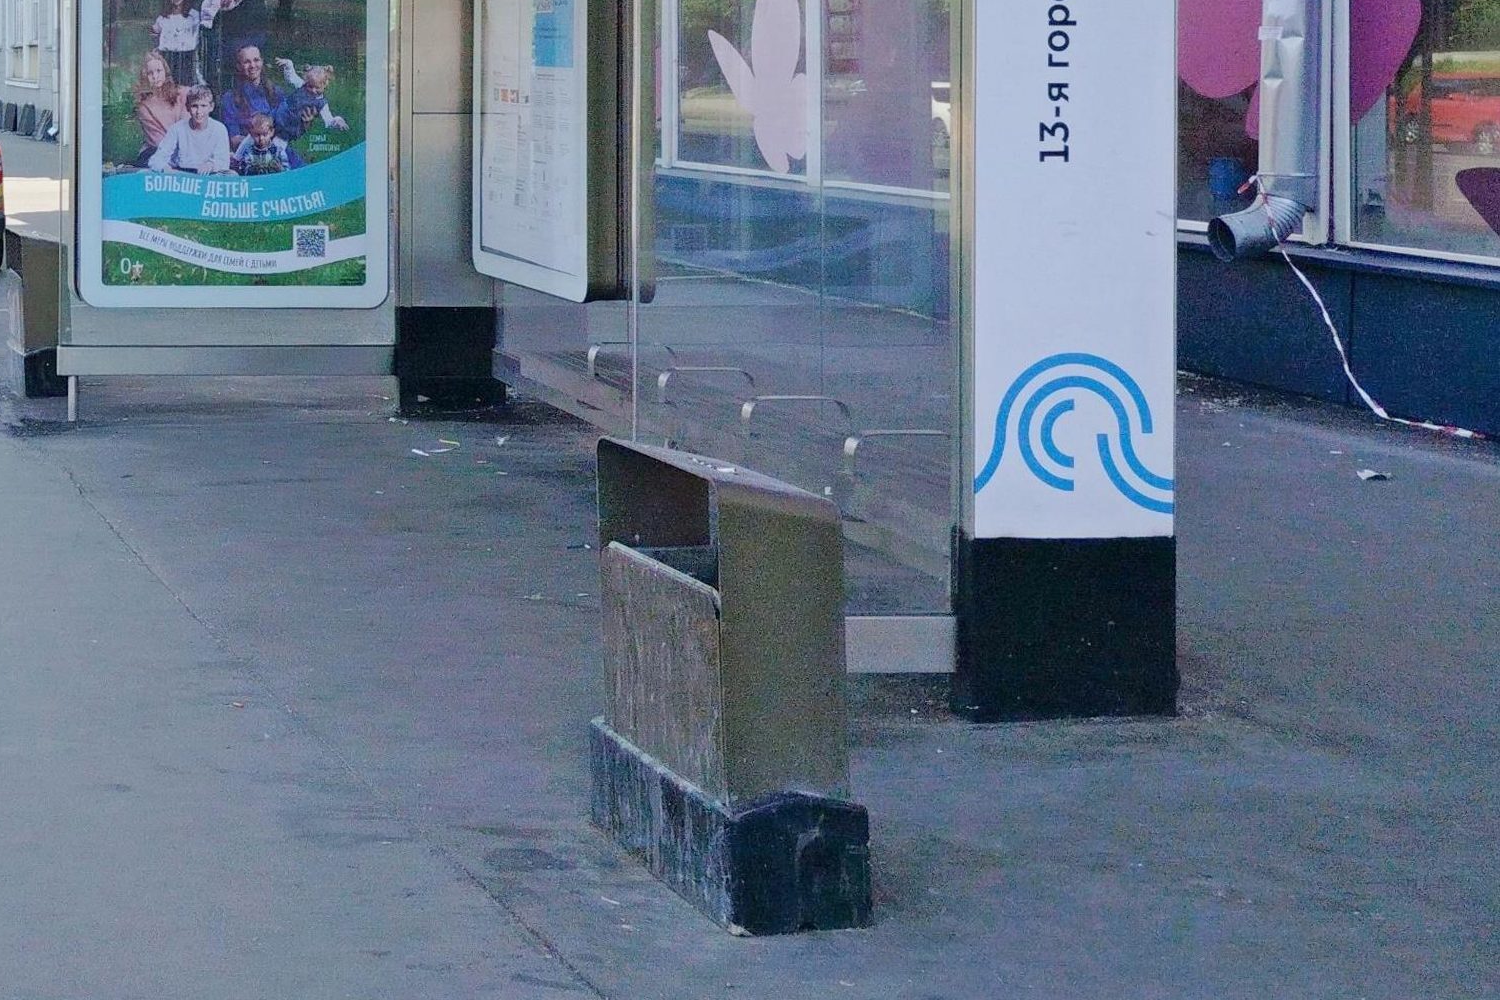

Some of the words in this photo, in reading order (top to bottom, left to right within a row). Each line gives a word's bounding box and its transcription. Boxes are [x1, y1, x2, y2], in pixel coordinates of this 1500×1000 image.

[1039, 82, 1070, 162] 13-я
[144, 175, 203, 196] БОЛЬШЕ
[204, 179, 249, 199] ДЕТЕЙ
[201, 200, 259, 219] БОЛЬШЕ
[261, 191, 327, 217] СЧАСТЬЯ!
